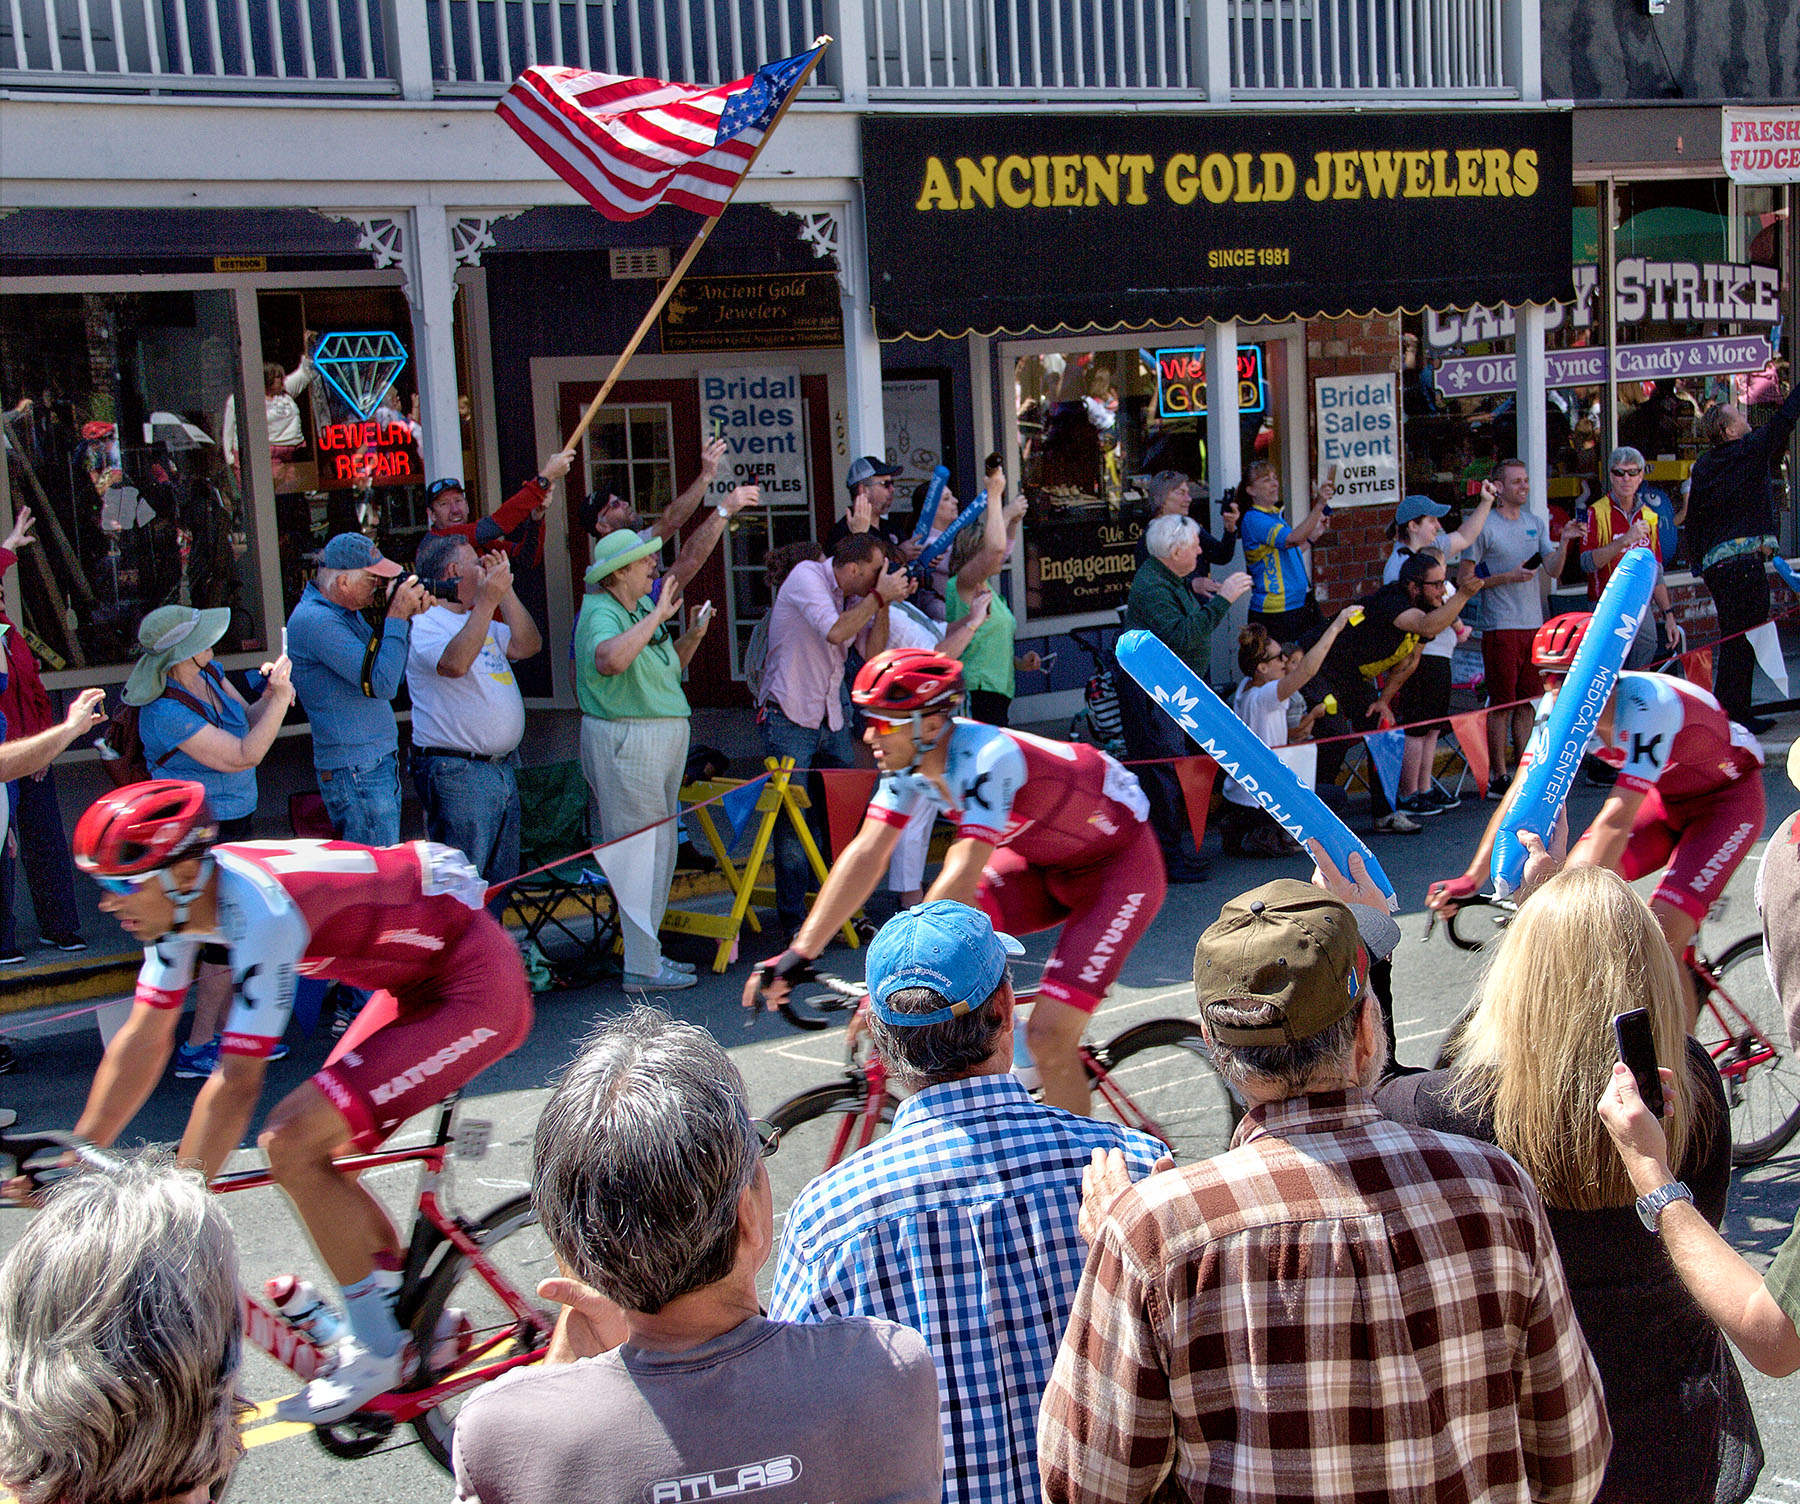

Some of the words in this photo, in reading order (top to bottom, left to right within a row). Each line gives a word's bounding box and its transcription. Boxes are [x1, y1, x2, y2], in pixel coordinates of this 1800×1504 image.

[1730, 121, 1800, 142] FRESH
[1730, 148, 1800, 171] FUDGE
[916, 154, 1154, 211] ANCIENT
[1164, 152, 1296, 206] GOLD
[1305, 149, 1540, 202] JEWELERS
[1208, 249, 1256, 269] SINCE
[1257, 248, 1290, 267] 1981
[699, 283, 763, 300] Ancient
[769, 278, 810, 300] Gold
[1615, 258, 1781, 323] STRIKE
[715, 303, 788, 323] Jewelers
[1160, 357, 1203, 380] We
[1476, 361, 1517, 388] Old
[1615, 350, 1685, 375] Candy
[1688, 347, 1703, 364] &
[1706, 344, 1757, 364] More
[704, 376, 796, 400] Bridal
[1166, 380, 1258, 411] GOD
[1320, 383, 1392, 409] Bridal
[708, 404, 794, 427] Sales
[1325, 411, 1392, 434] Sales
[318, 421, 414, 450] JEWELRY
[1324, 435, 1392, 460] Event
[336, 451, 411, 479] REPAIR
[734, 463, 776, 476] OVER
[1343, 465, 1377, 479] OVER
[708, 481, 737, 494] 100
[1349, 479, 1396, 495] STYLES
[1098, 525, 1125, 543] We
[1570, 665, 1612, 735] MEDICAL
[1542, 739, 1578, 805] CENTER
[652, 1457, 794, 1504] ATLAS
